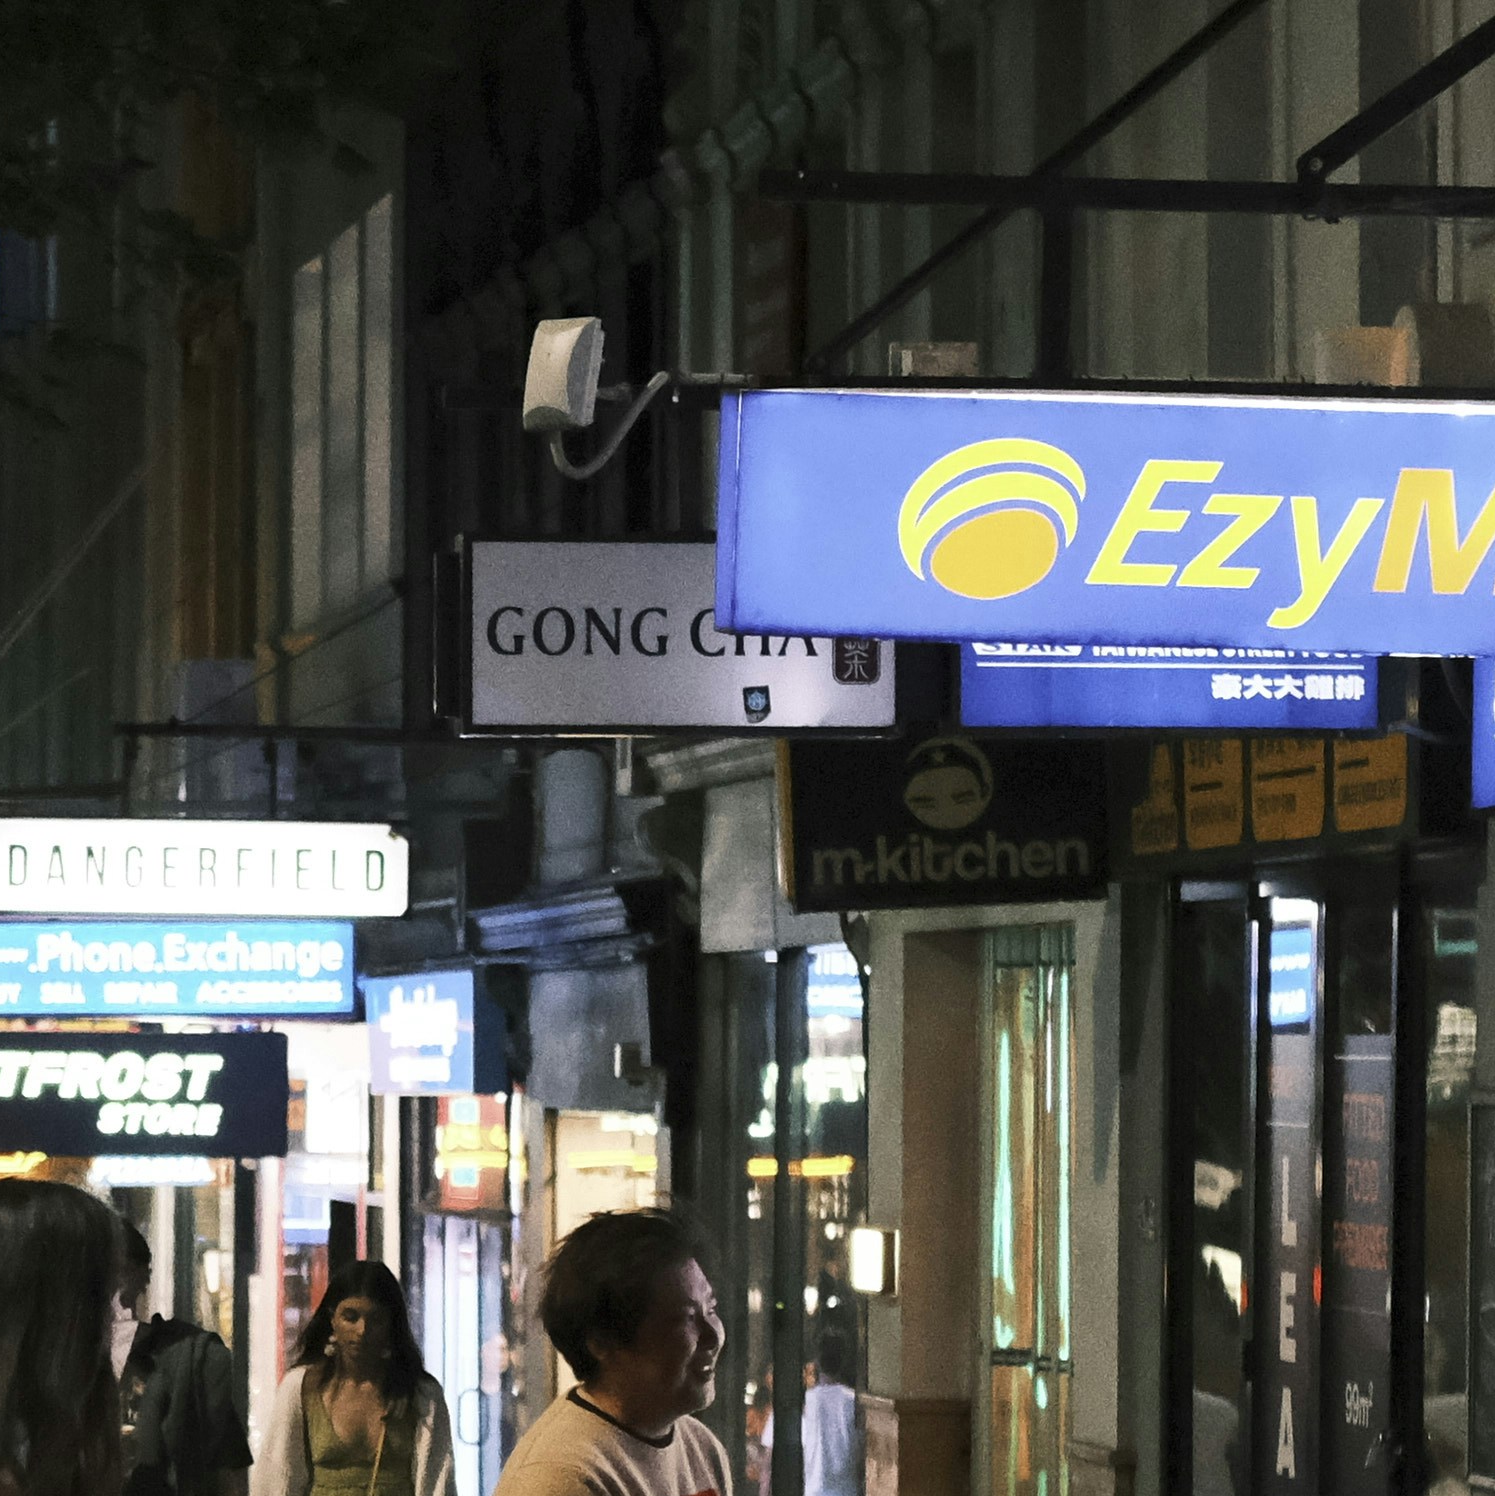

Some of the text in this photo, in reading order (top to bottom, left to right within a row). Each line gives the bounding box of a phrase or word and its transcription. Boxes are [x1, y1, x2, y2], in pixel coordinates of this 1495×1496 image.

[486, 606, 669, 657] GONG
[8, 844, 386, 892] DANGERFIELD
[96, 1102, 224, 1137] STORE
